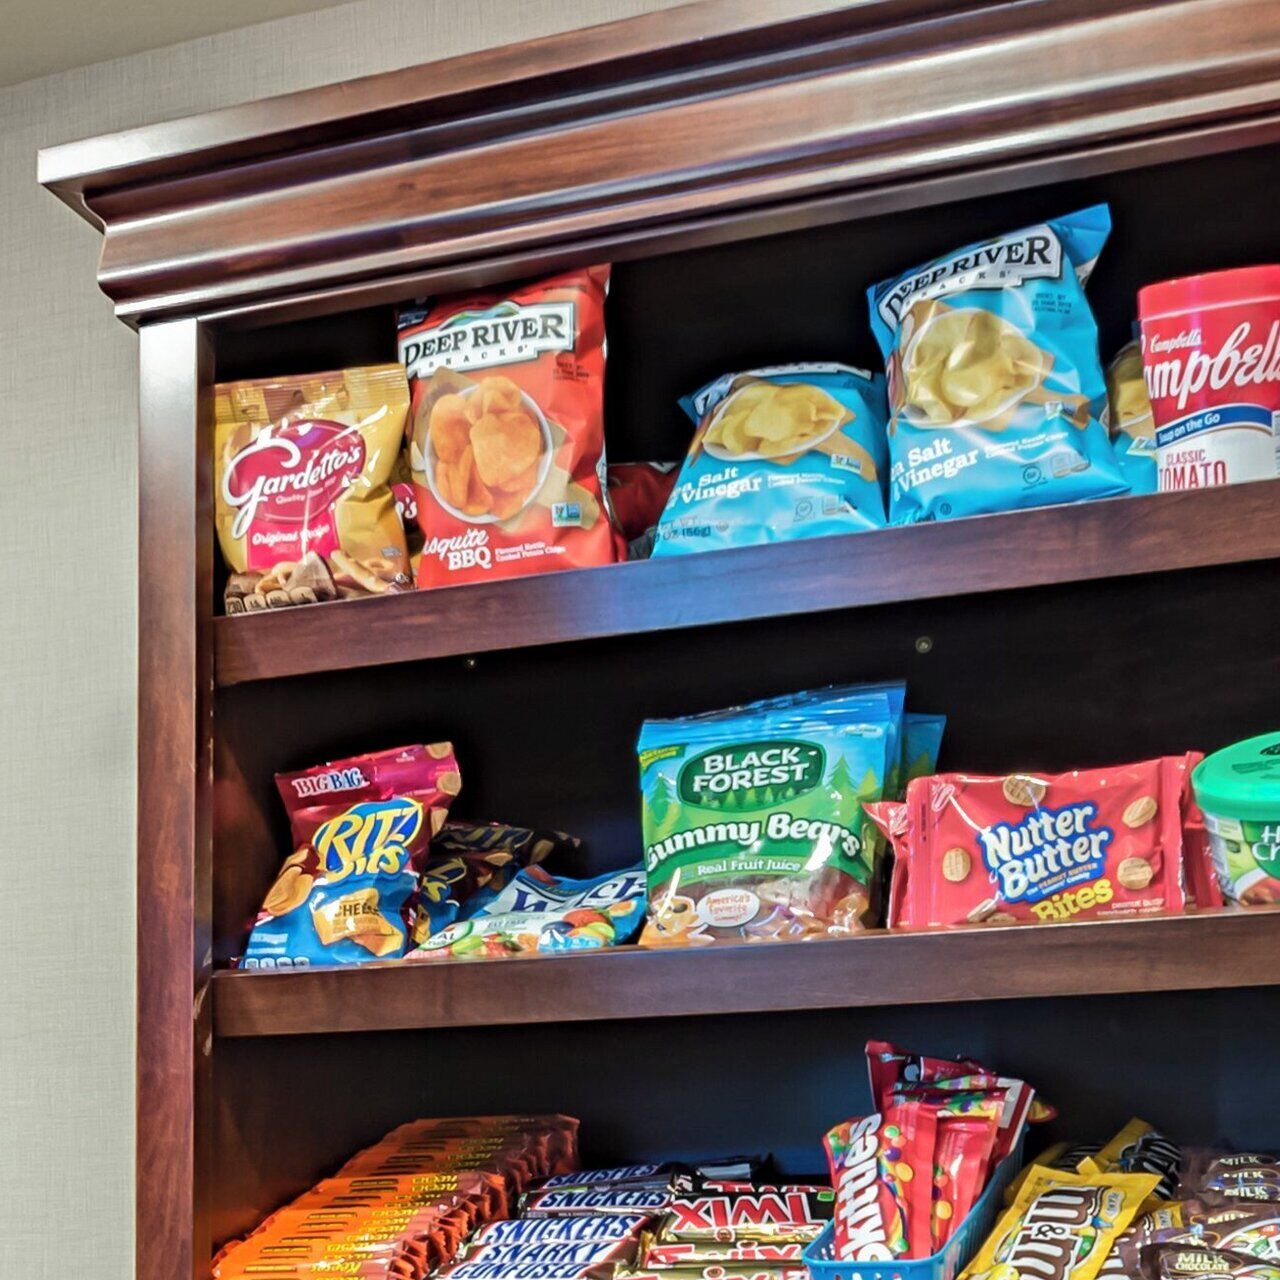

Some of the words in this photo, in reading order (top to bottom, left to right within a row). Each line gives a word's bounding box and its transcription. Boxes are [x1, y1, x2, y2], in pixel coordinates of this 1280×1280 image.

[886, 266, 947, 322] DEEP
[951, 235, 1052, 276] RIVER
[404, 329, 467, 367] DEEP
[472, 313, 566, 348] RIVER
[1187, 416, 1204, 433] the
[1204, 411, 1220, 427] Go
[908, 437, 953, 468] Salt
[1166, 449, 1206, 467] CLASSIC
[699, 466, 738, 486] Salt
[897, 449, 979, 493] Vinegar
[1160, 460, 1227, 493] TOMATO
[223, 436, 362, 540] Gardetto's
[681, 476, 762, 504] Vinegar
[252, 532, 298, 546] Original
[423, 529, 489, 560] squite
[448, 546, 492, 570] BBQ
[703, 747, 800, 774] BLACK
[295, 776, 329, 796] BIG
[329, 769, 364, 792] BAG
[693, 763, 810, 792] FOREST
[318, 803, 421, 871] RITZ
[768, 814, 862, 857] Bears
[984, 806, 1094, 862] Nutter
[698, 861, 727, 876] Real
[731, 859, 764, 871] Fruit
[767, 859, 801, 873] Juice
[998, 829, 1110, 898] Butter
[1031, 878, 1114, 922] Bites
[541, 1191, 667, 1209] SNICKERS
[485, 1215, 638, 1243] SNICKERS
[482, 1243, 610, 1263] SNARKY
[1175, 1261, 1228, 1272] CHOCOLATE
[1177, 1252, 1224, 1264] MILK
[452, 1263, 586, 1279] CONFUSED
